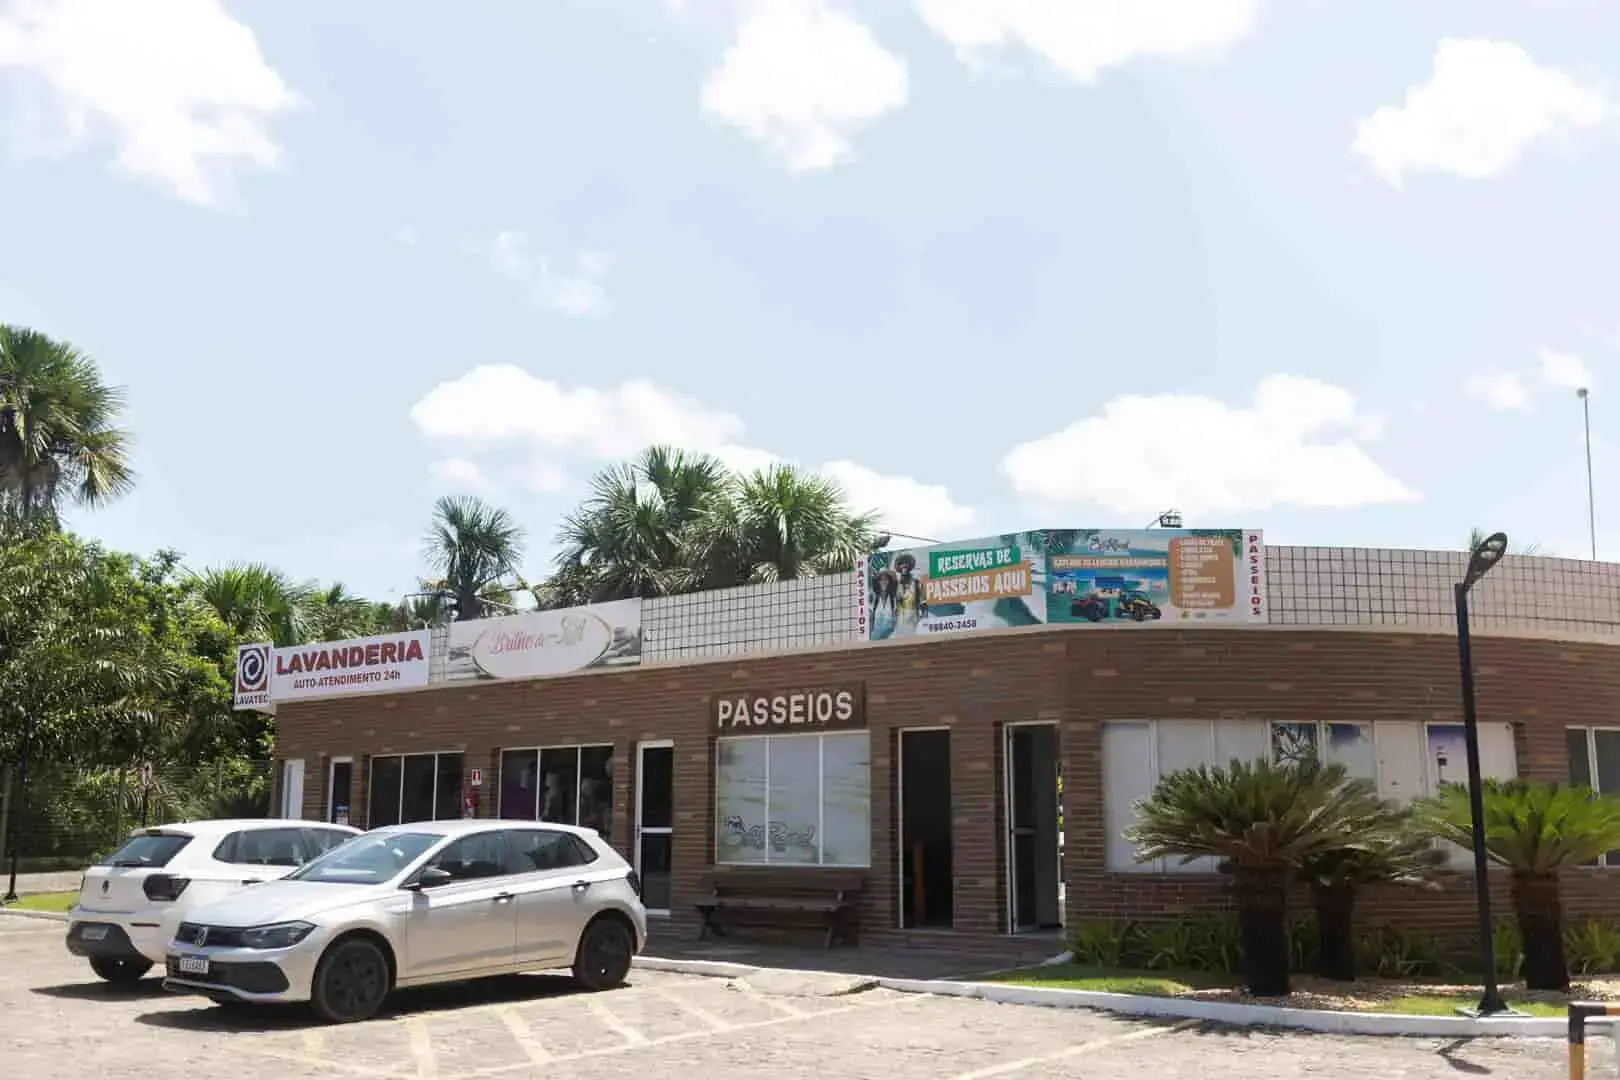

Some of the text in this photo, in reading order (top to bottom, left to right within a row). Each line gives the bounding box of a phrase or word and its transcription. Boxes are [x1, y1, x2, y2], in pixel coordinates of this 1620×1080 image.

[937, 548, 1012, 574] RESERVAS DE
[926, 575, 990, 601] PASSEIOS
[1248, 535, 1261, 616] PASSEIOS
[276, 639, 424, 676] LAVANDERIA
[383, 670, 401, 681] 24h
[235, 695, 270, 706] LAVATEC
[717, 691, 853, 729] PASSEIOS
